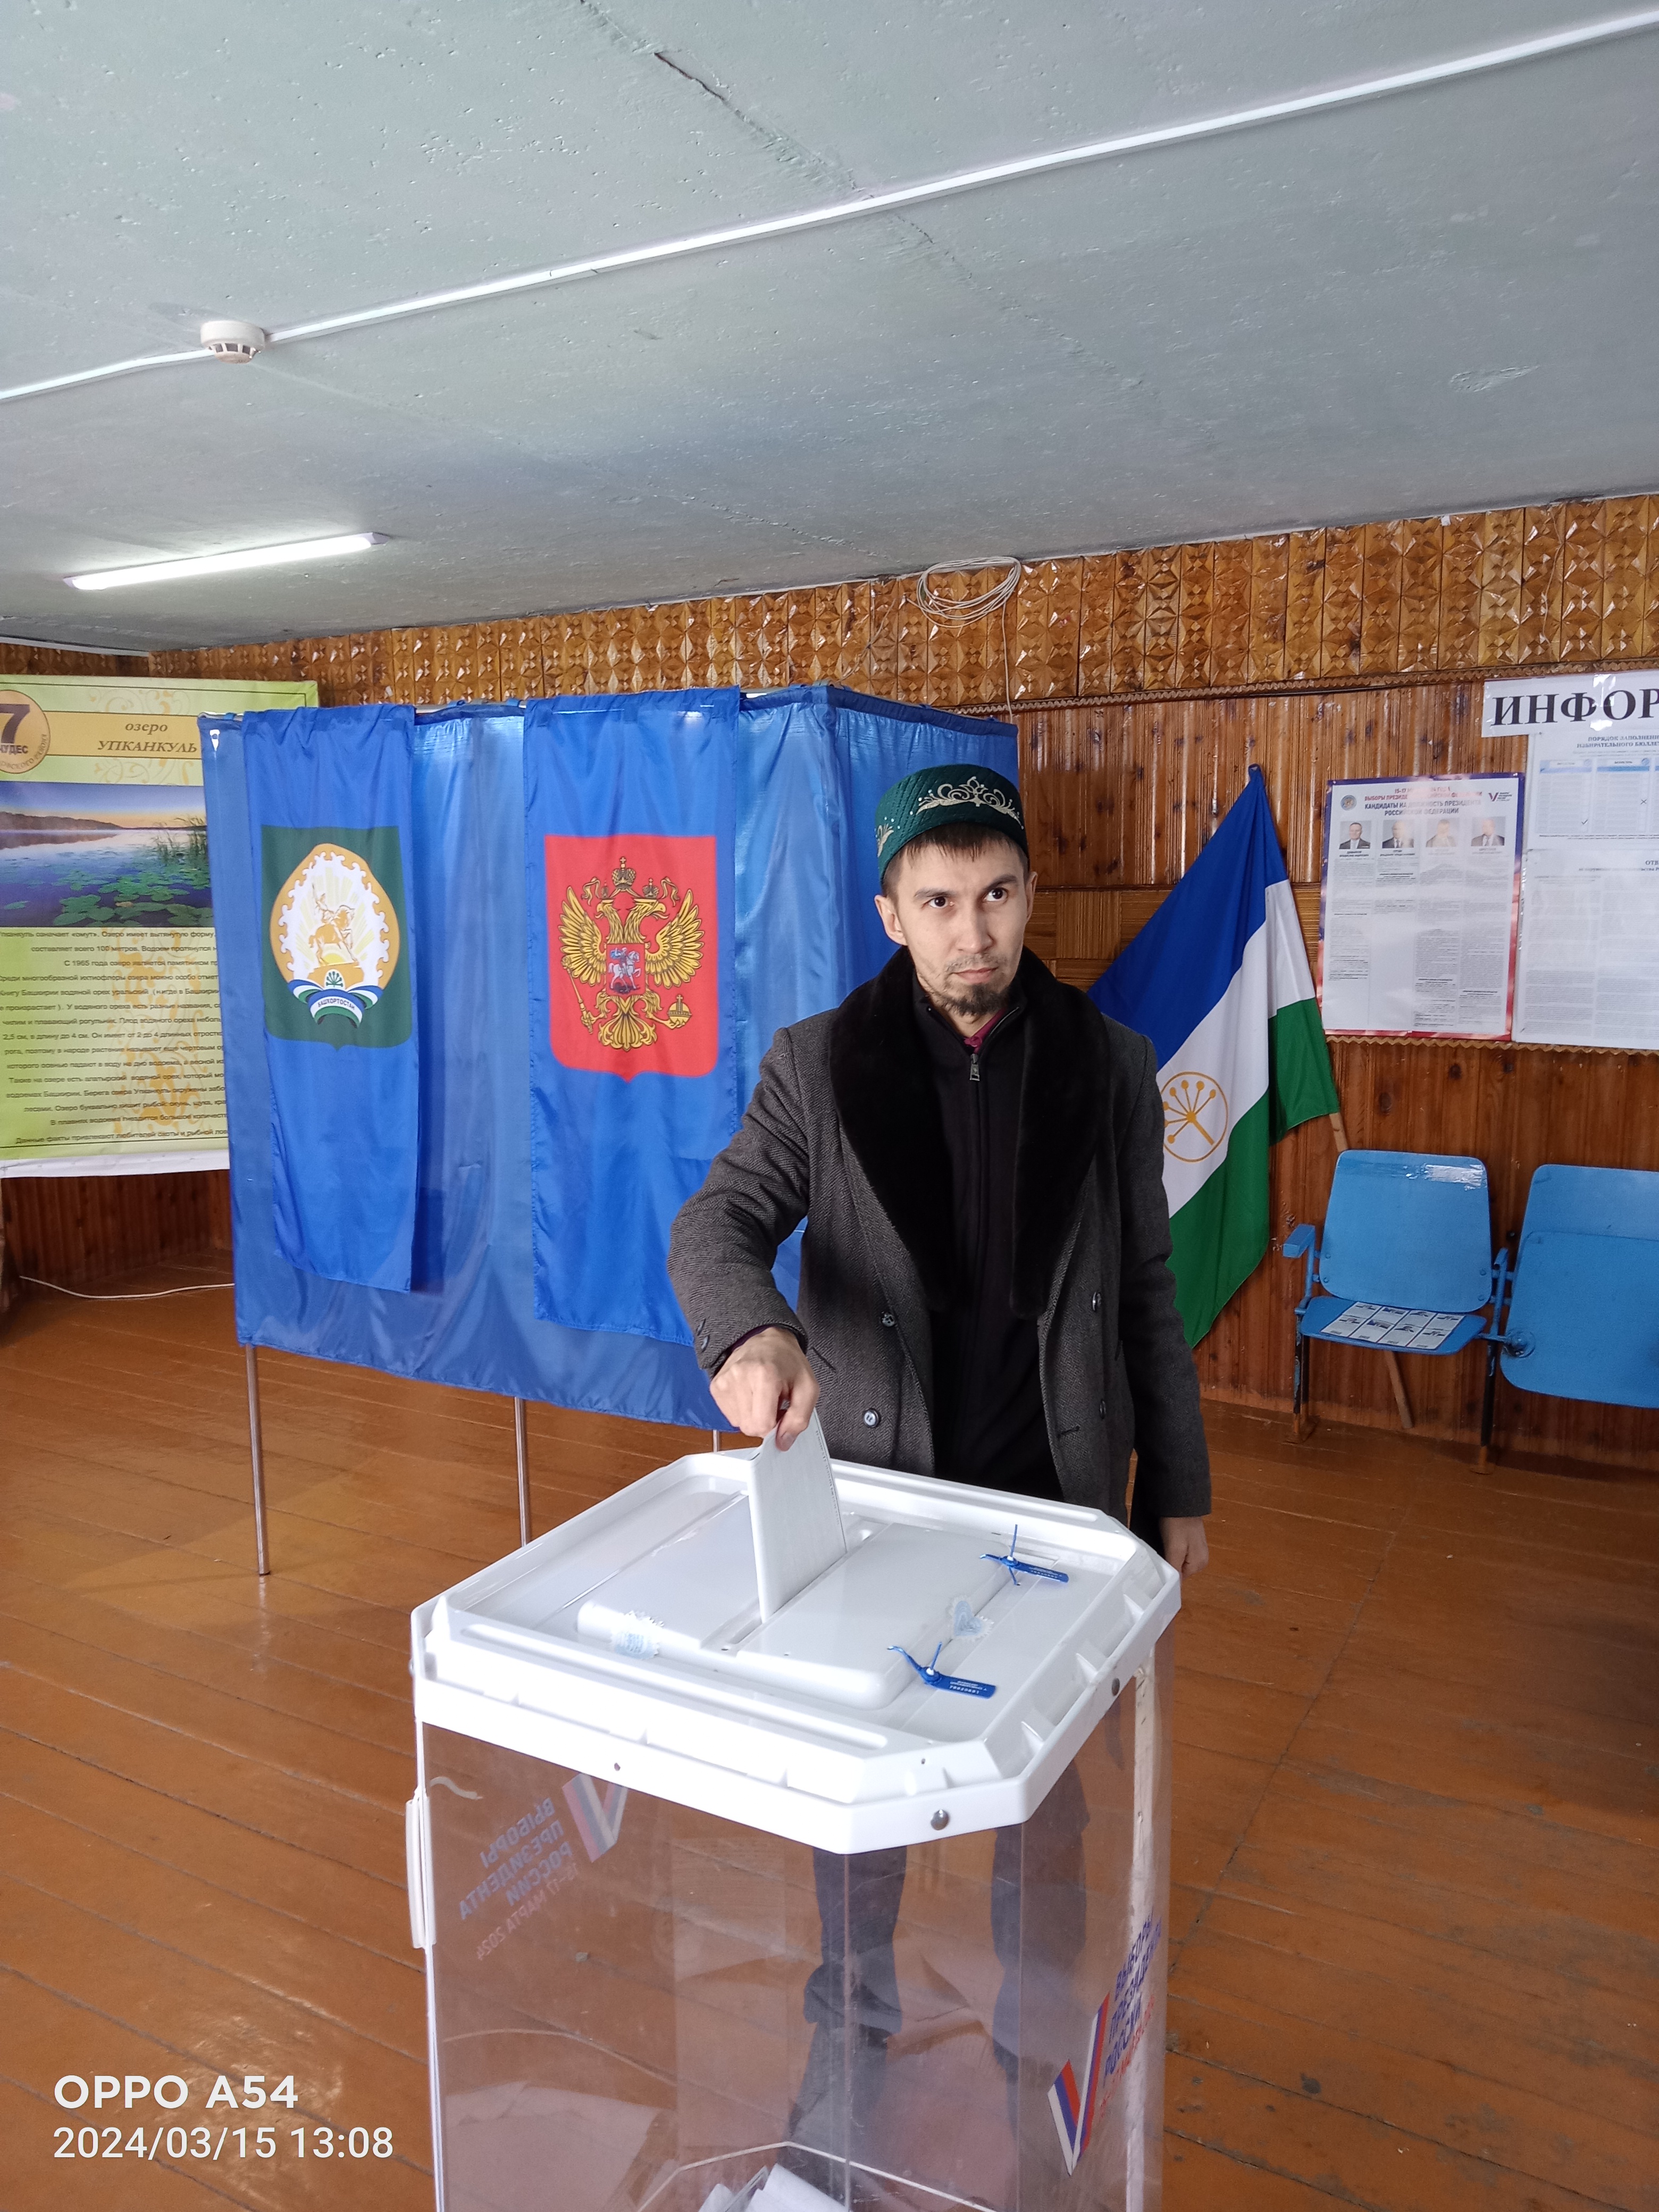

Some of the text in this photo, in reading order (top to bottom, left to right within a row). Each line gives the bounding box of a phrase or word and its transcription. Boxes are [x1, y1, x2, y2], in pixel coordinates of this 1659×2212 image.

[1490, 688, 1659, 726] ИНФОР
[0, 703, 30, 744] 7
[125, 723, 168, 735] озеро
[98, 740, 197, 752] УПКАНКУЛЬ
